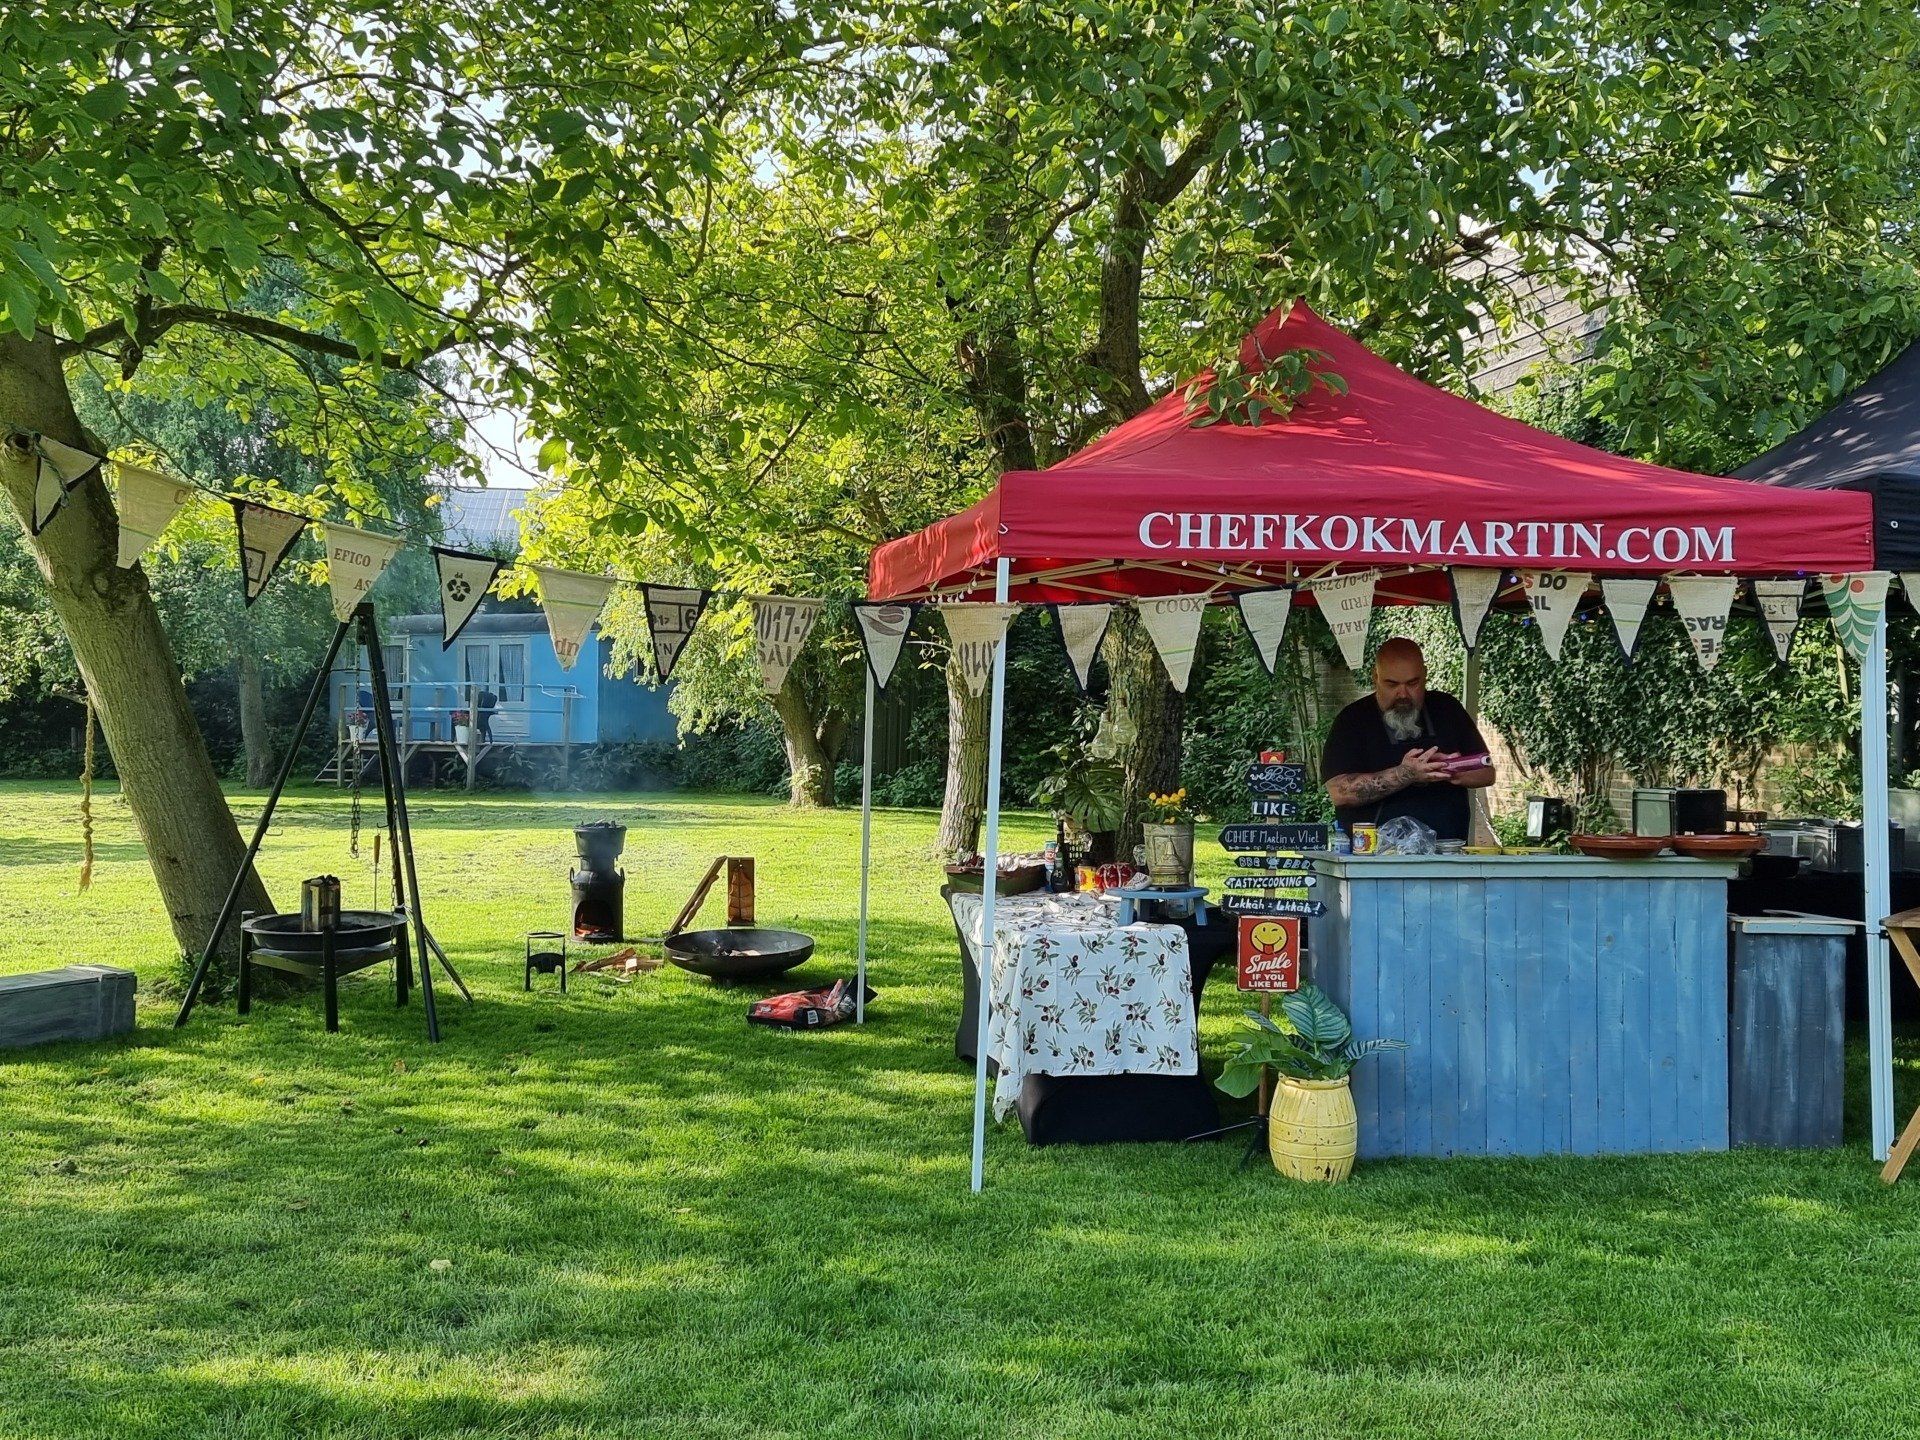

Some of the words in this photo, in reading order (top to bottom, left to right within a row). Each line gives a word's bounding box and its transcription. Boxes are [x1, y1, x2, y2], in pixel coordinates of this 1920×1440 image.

[1138, 511, 1736, 562] CHEFKOKMARTIN.COM
[334, 548, 371, 567] EFICO
[1539, 573, 1567, 590] DO
[1253, 801, 1296, 816] LIKE:
[1225, 830, 1257, 843] CHEF
[1283, 859, 1310, 869] BBQ
[1245, 952, 1292, 974] Smile
[1252, 973, 1262, 981] IF
[1264, 973, 1285, 981] YOU
